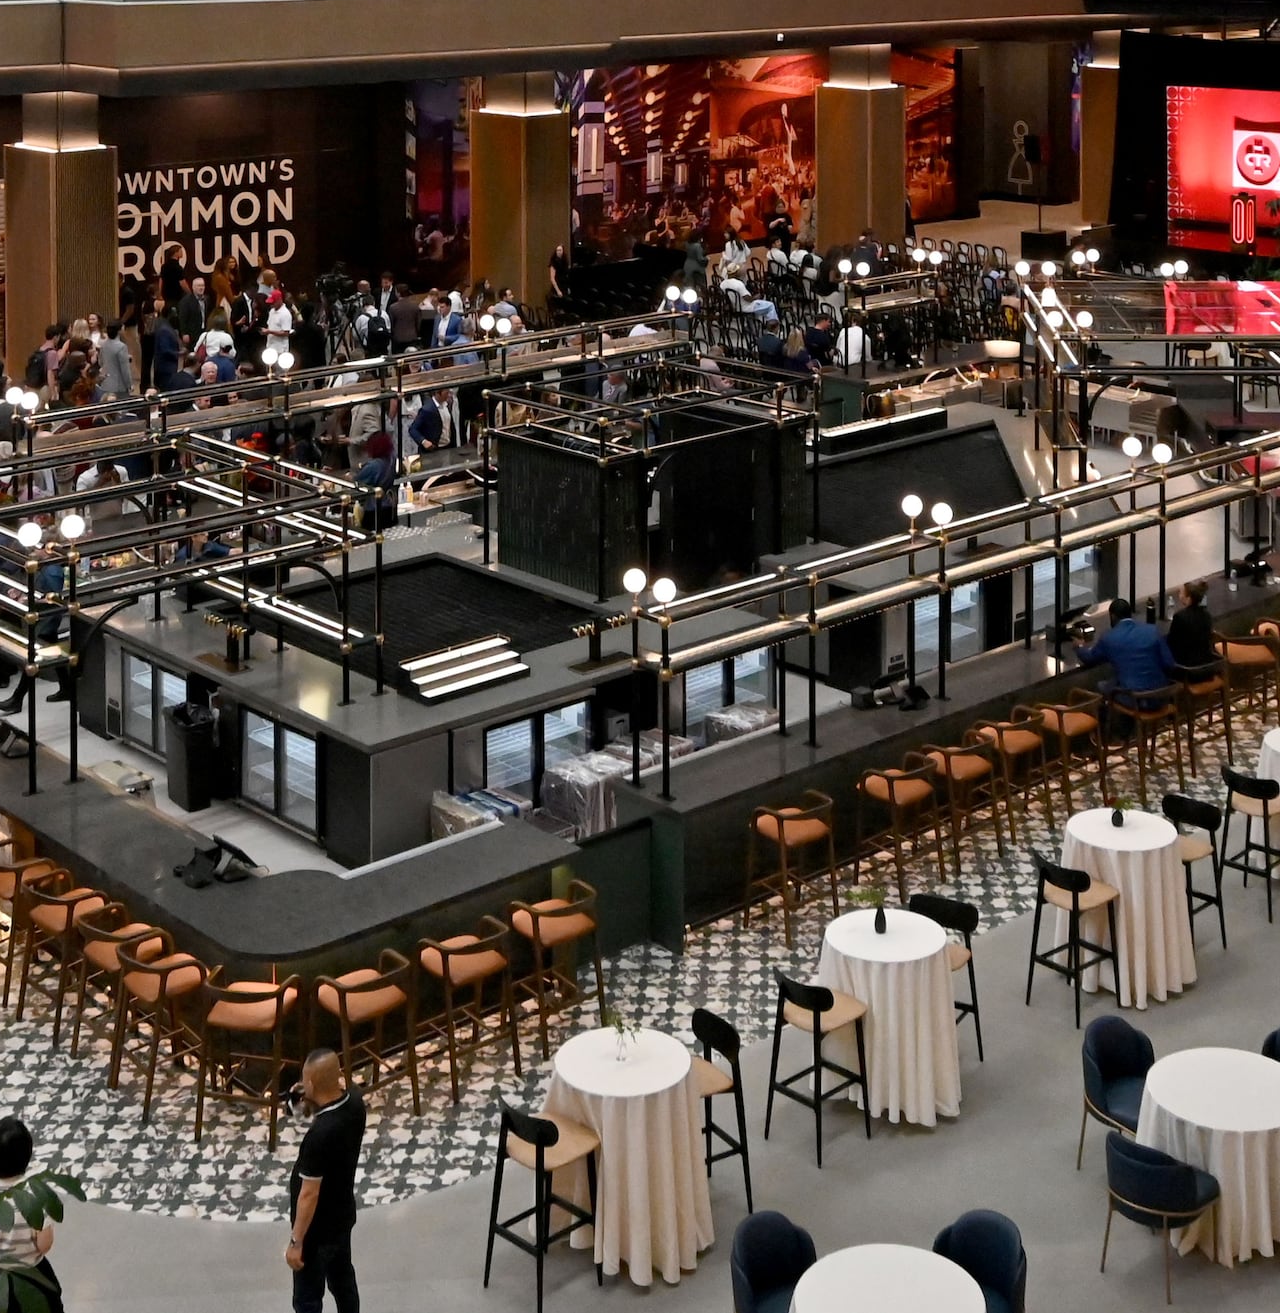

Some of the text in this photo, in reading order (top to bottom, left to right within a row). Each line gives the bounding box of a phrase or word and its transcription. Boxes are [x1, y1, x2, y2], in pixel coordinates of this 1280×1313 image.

[117, 159, 295, 195] WNTOWN'S
[1244, 153, 1272, 168] CTR
[117, 187, 293, 239] OMMON
[117, 228, 296, 282] ROUND
